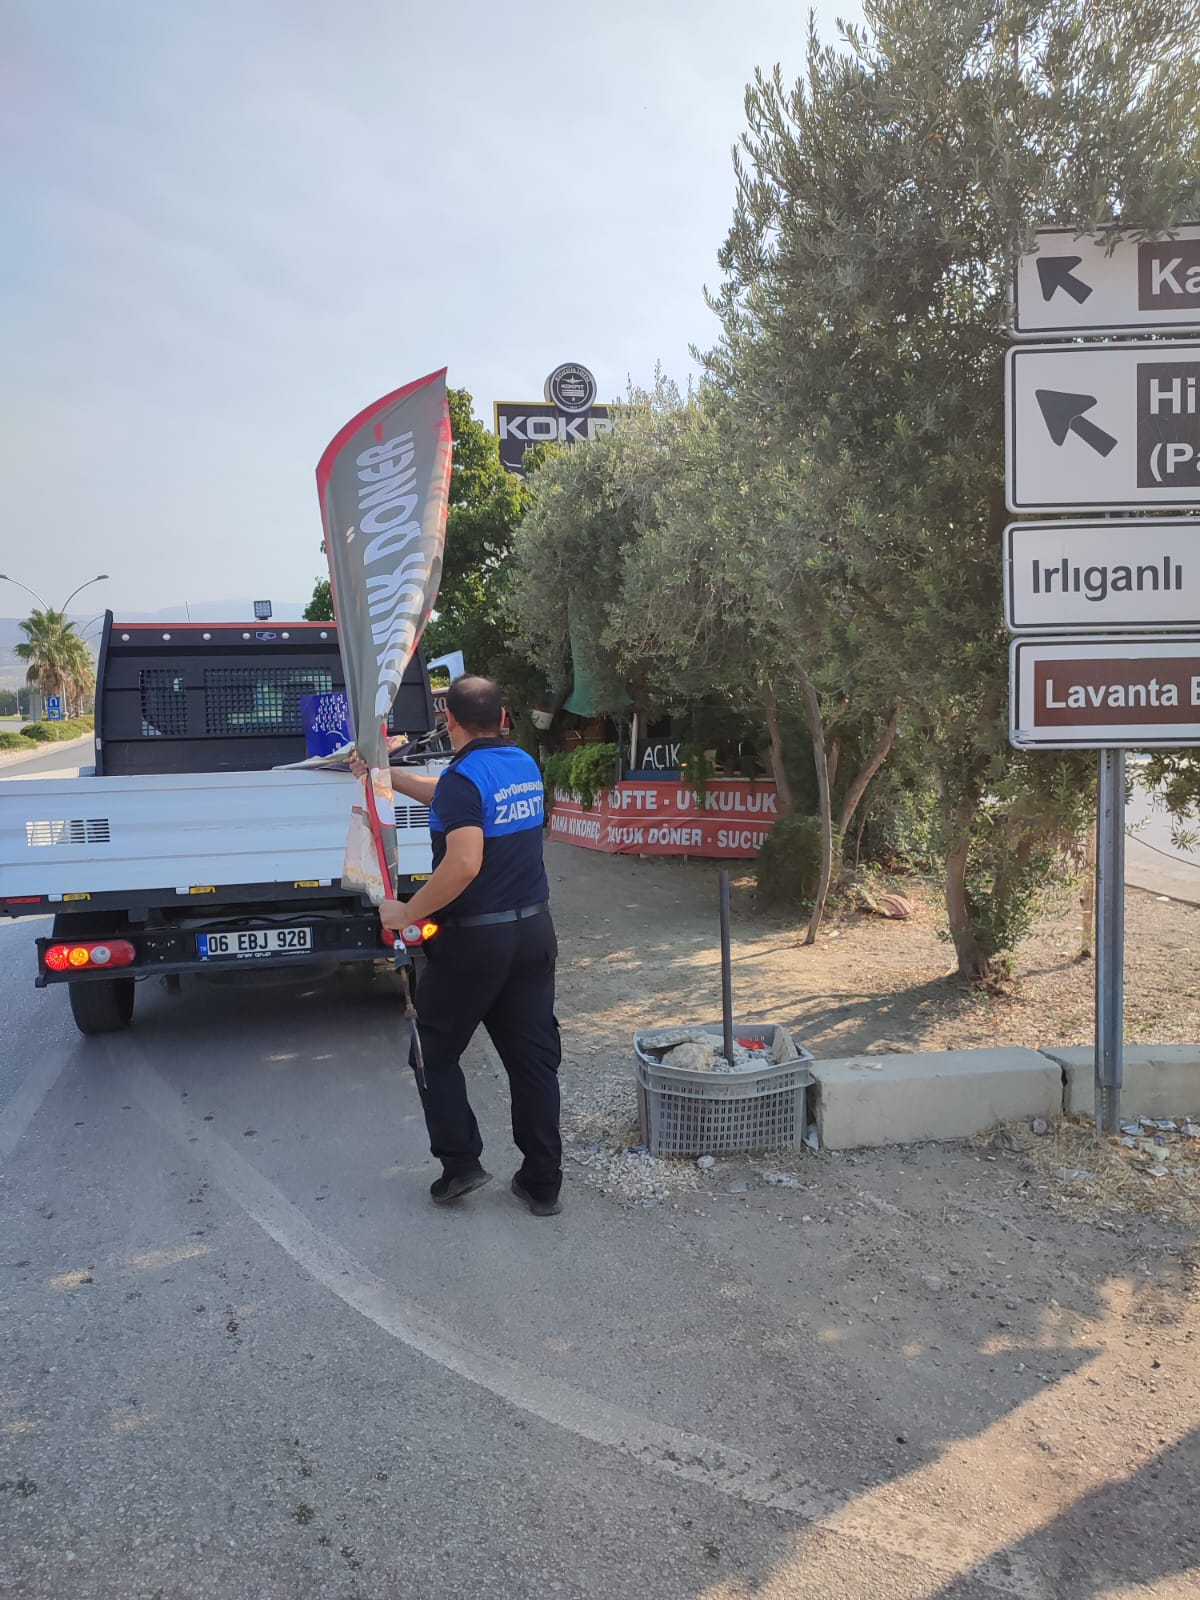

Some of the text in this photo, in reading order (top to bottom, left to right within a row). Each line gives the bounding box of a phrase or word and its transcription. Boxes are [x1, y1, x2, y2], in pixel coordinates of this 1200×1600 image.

[1150, 378, 1196, 414] Hi
[1150, 443, 1200, 482] (P
[346, 431, 422, 566] DÖNER
[1032, 556, 1182, 602] Irlıganlı
[1046, 677, 1178, 709] Lavanta
[642, 743, 681, 770] AÇIK
[607, 785, 657, 810] KÖFTE
[648, 823, 703, 847] DÖNER
[717, 829, 769, 850] SUCU
[208, 930, 307, 953] 06 EBJ 928
